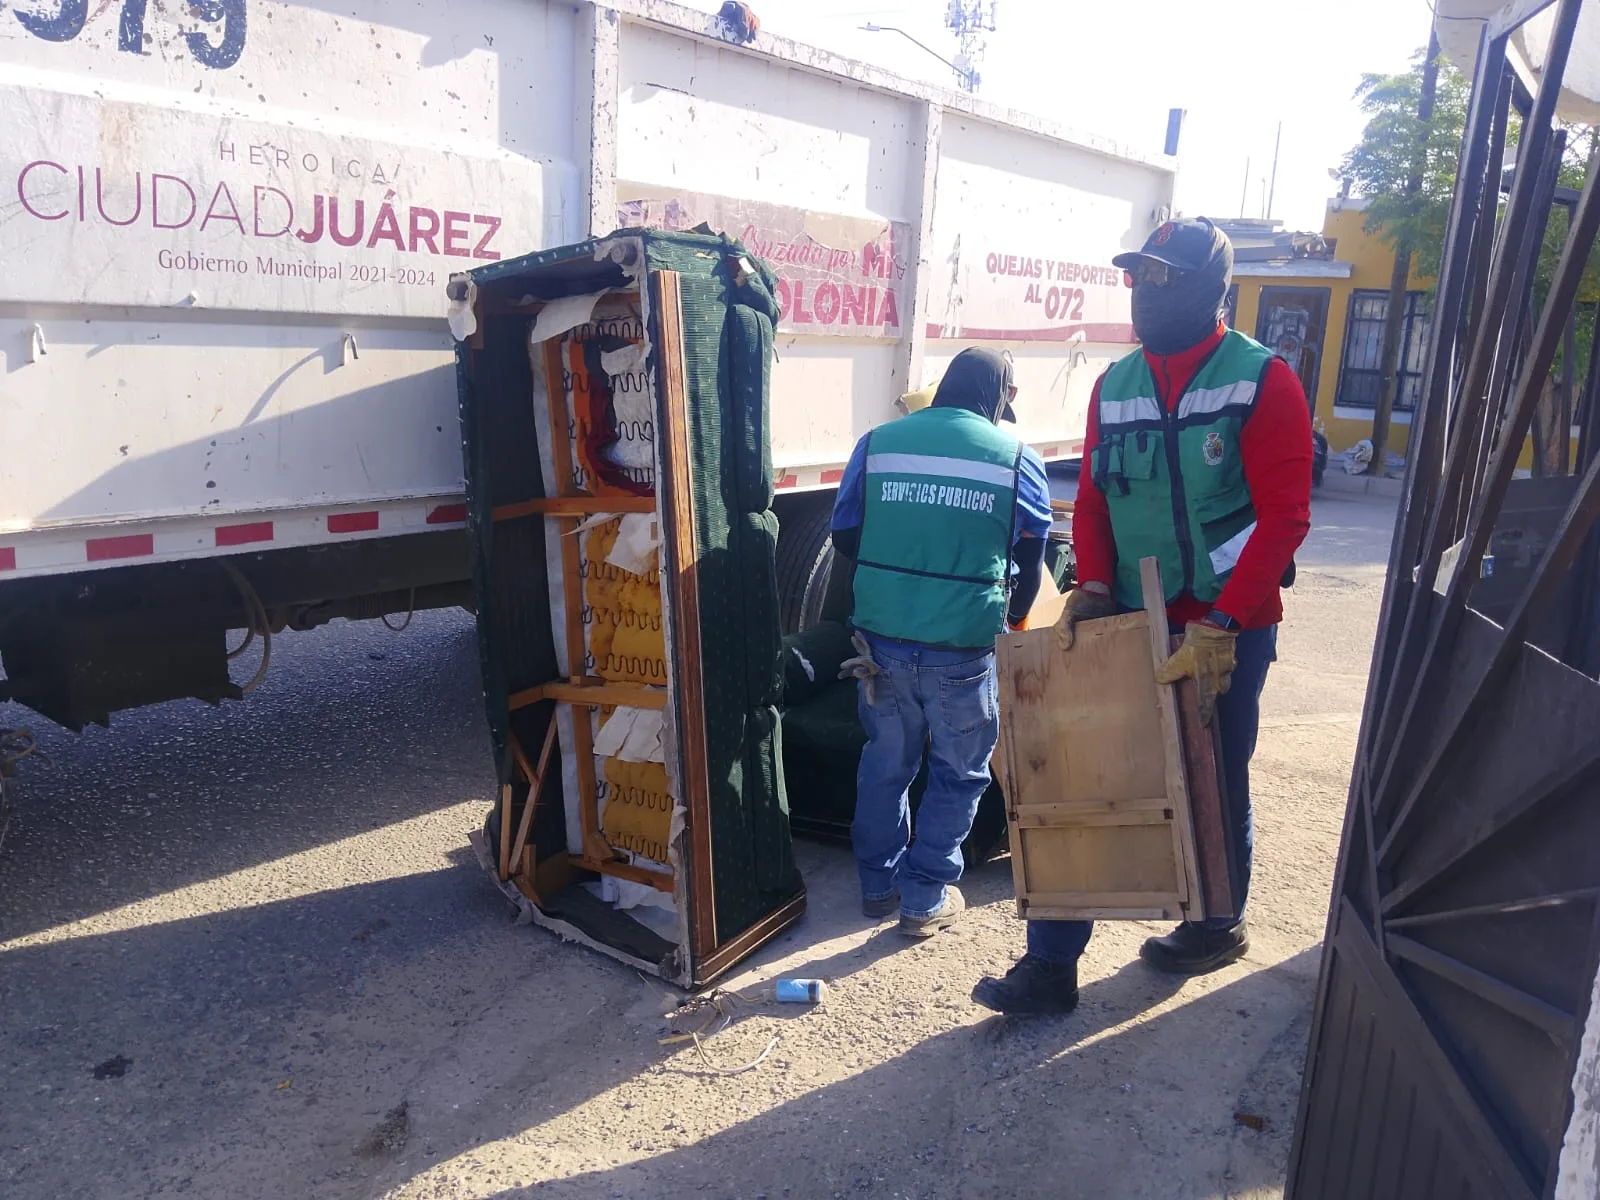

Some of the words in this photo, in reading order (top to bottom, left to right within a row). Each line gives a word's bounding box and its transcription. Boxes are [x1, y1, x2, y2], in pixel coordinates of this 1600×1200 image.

[219, 141, 388, 182] HEROICA
[17, 160, 294, 238] CIUDAD
[295, 189, 501, 260] JUÁREZ
[158, 249, 248, 274] Gobierno
[256, 256, 343, 283] Municipal
[349, 264, 436, 287] 2021-2024
[986, 252, 1043, 279] QUEJAS
[1046, 259, 1055, 280] Y
[1057, 262, 1119, 287] REPORTES
[776, 278, 899, 328] OLONIA
[1024, 283, 1042, 303] AL
[1045, 285, 1085, 320] 072
[937, 485, 995, 513] PUBLICOS
